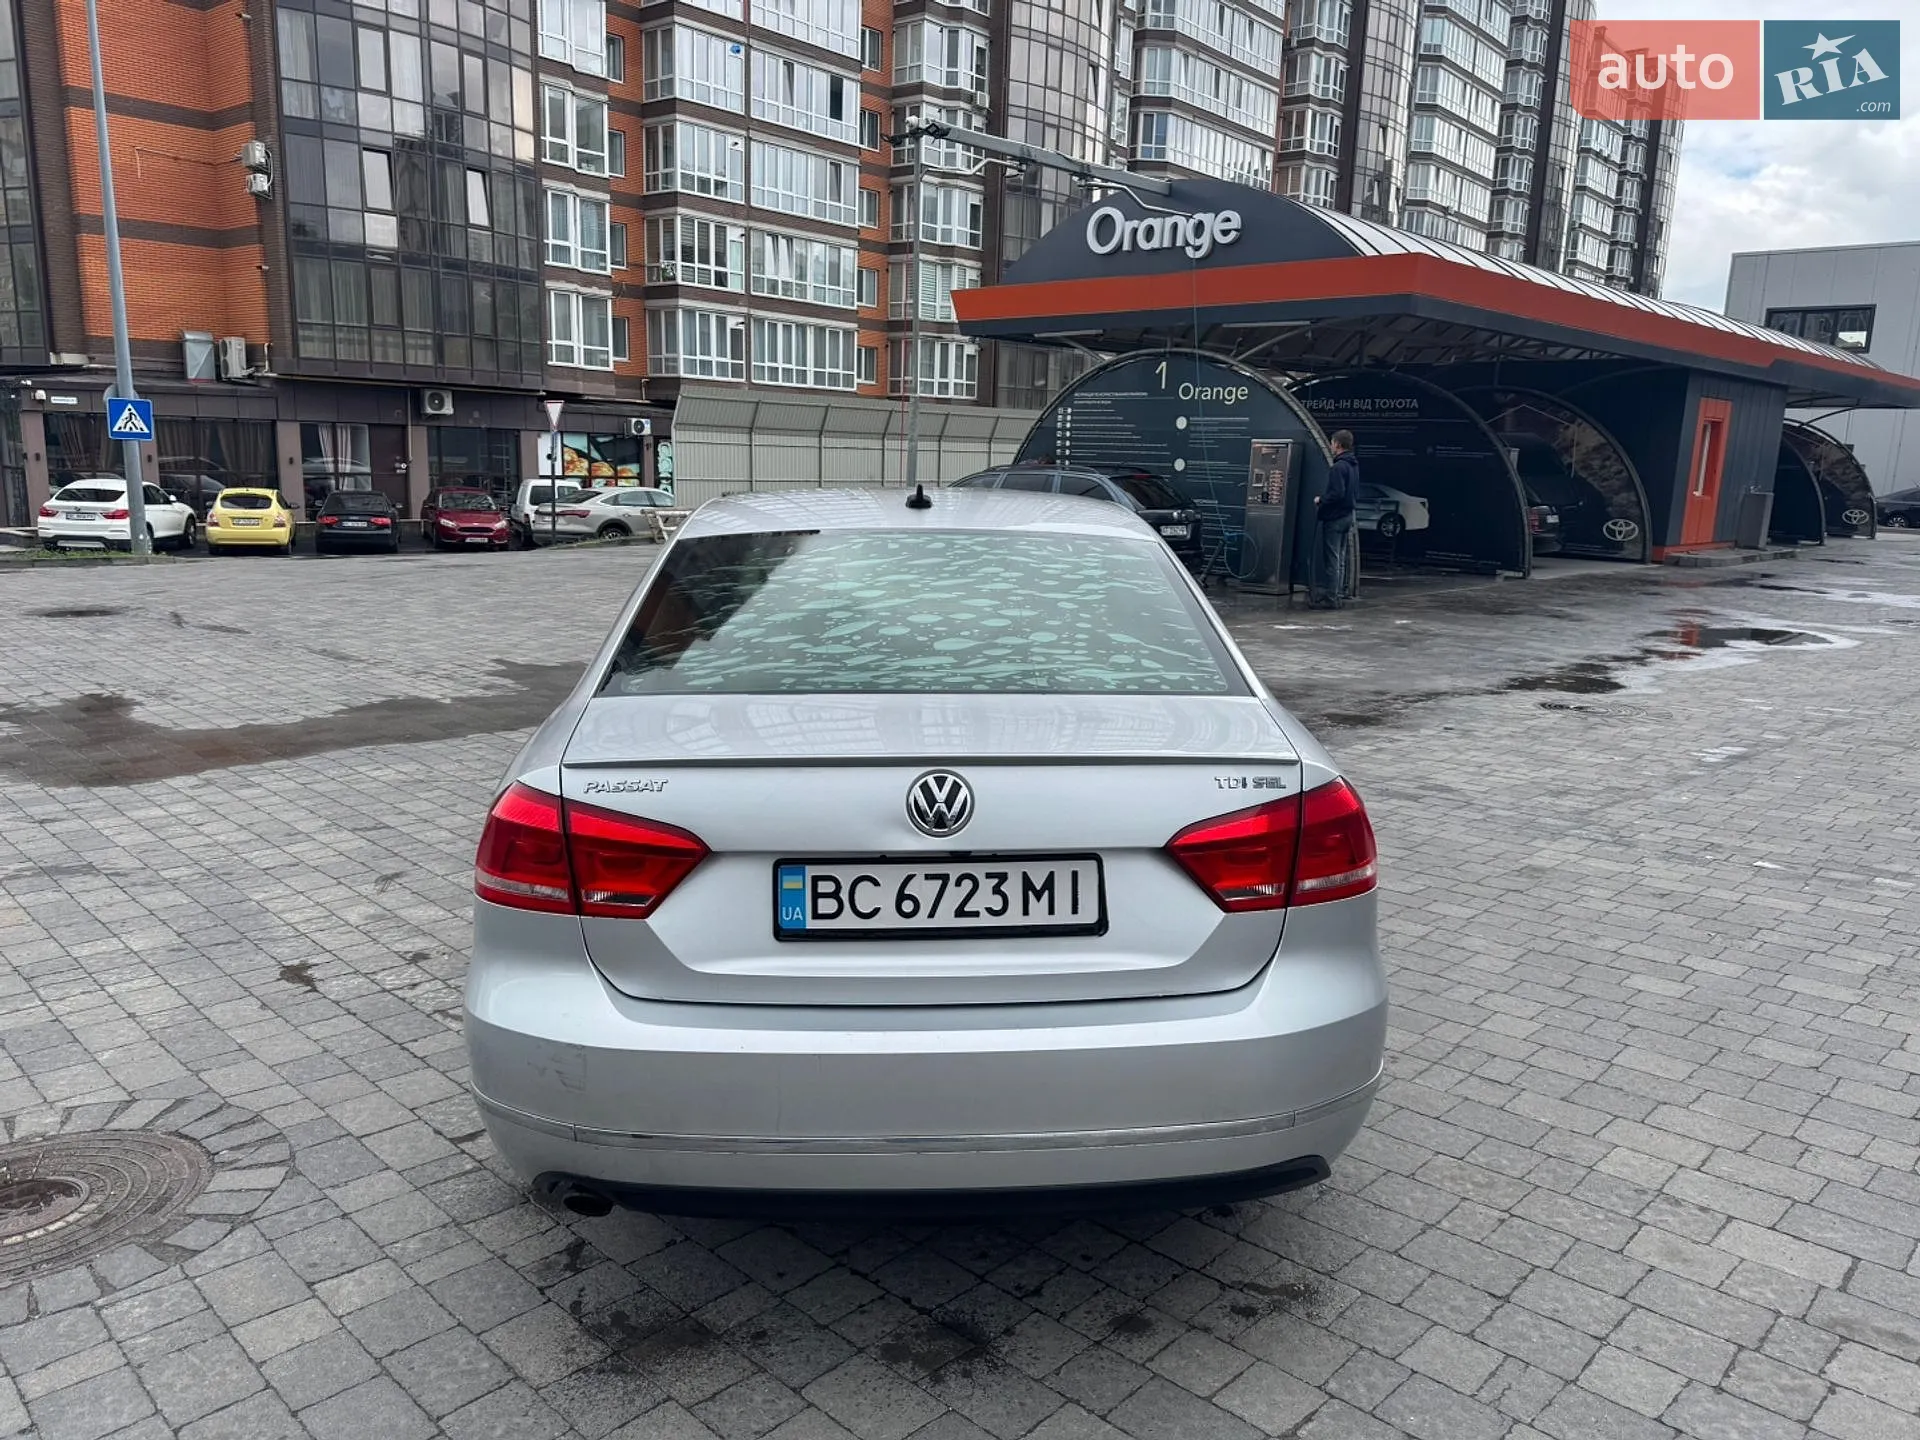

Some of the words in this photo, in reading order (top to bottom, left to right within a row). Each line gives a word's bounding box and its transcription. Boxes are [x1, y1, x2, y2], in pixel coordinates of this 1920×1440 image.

[1086, 206, 1242, 259] Orange
[1155, 361, 1167, 390] 1
[1178, 382, 1249, 405] Orange
[1373, 398, 1419, 409] TOYOTA
[583, 779, 669, 794] PASSAT
[1214, 776, 1247, 789] TDI
[1252, 776, 1287, 789] SEL
[811, 874, 881, 920] BC
[894, 871, 1009, 919] 6723
[1021, 869, 1079, 917] MI
[782, 907, 803, 921] UA
